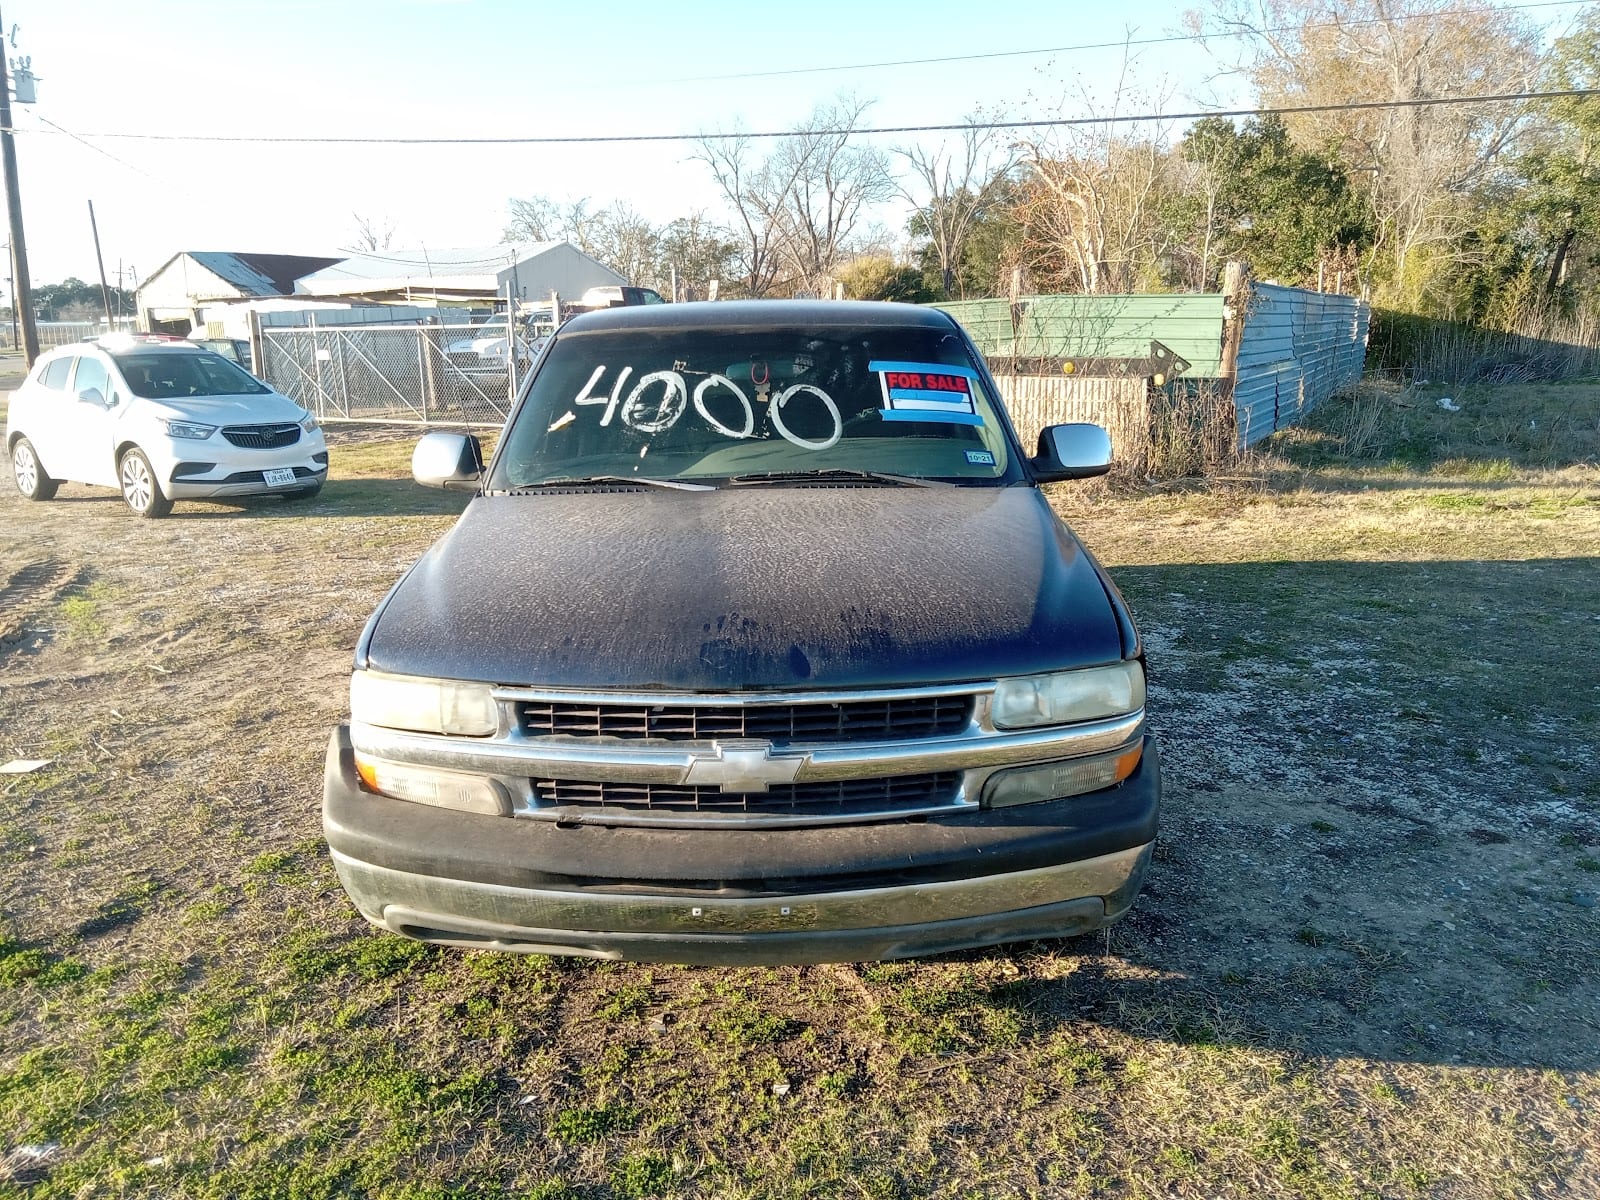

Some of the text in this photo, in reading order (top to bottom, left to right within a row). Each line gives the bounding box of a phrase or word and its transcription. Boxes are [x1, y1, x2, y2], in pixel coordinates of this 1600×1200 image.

[575, 365, 843, 450] 4000
[887, 373, 969, 393] FOR SALE
